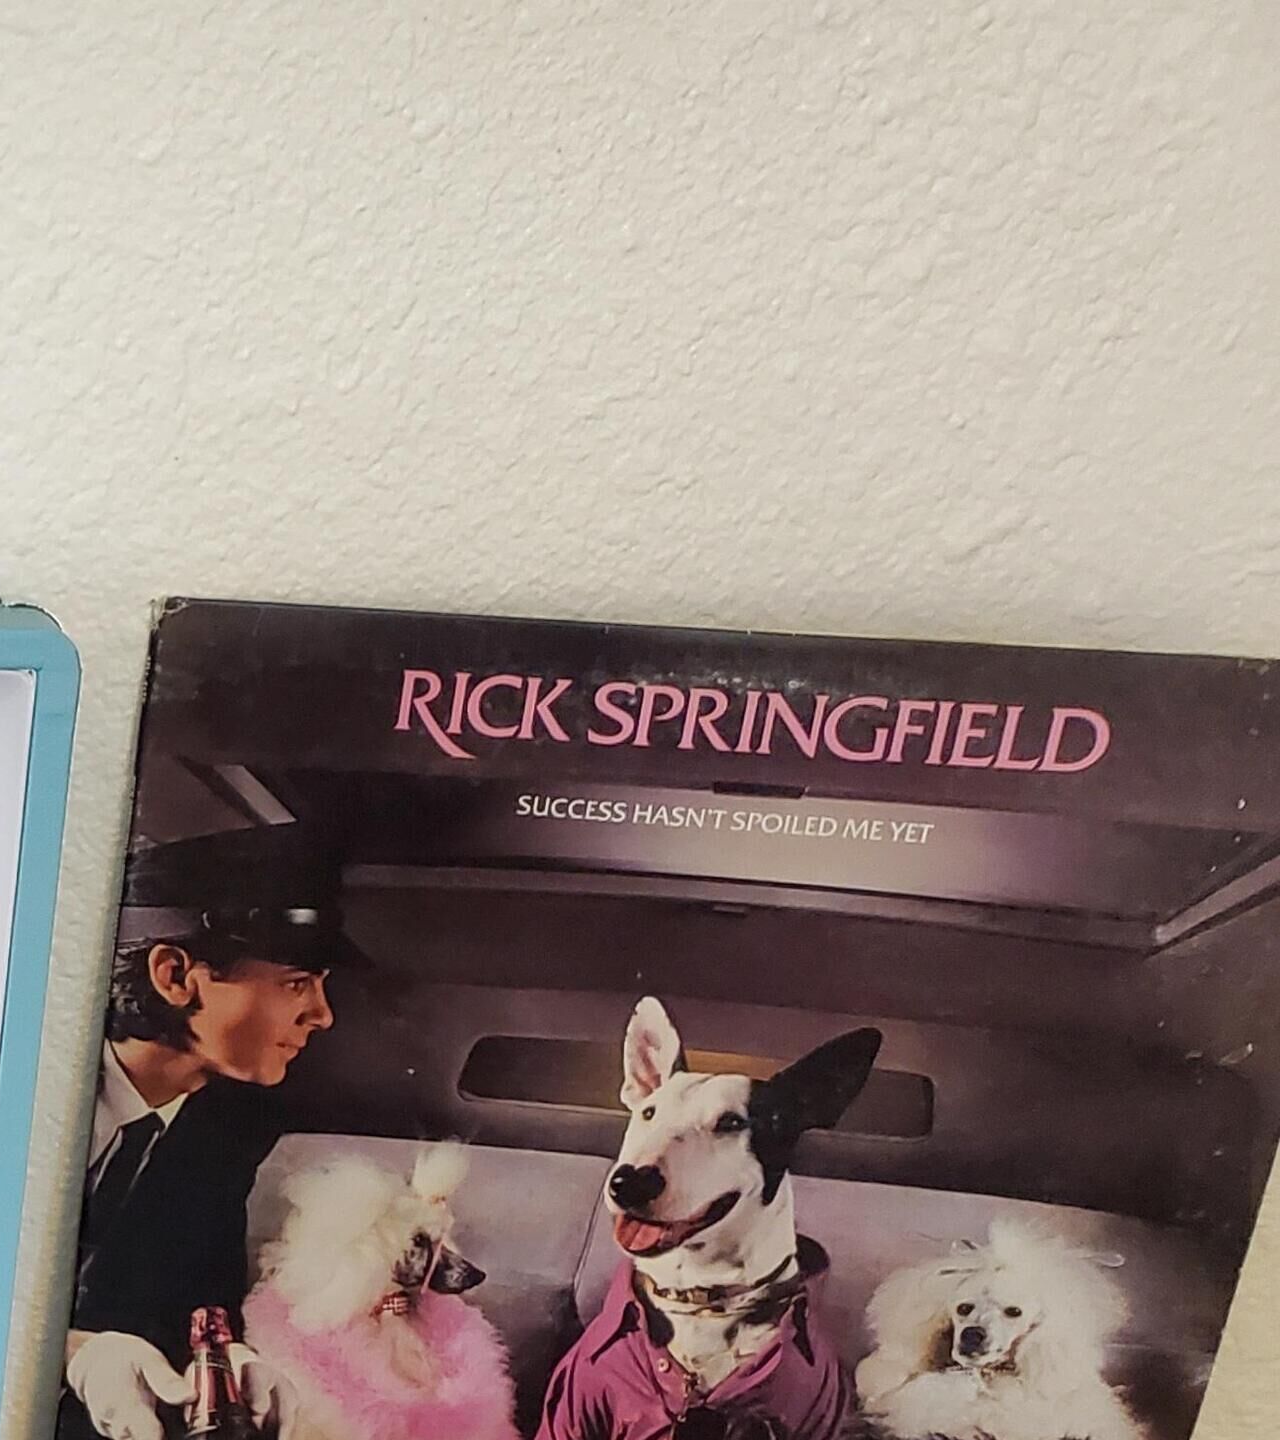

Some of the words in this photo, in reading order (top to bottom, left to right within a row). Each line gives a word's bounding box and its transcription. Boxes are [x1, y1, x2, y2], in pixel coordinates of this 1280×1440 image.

[393, 668, 572, 759] RICK
[586, 680, 1111, 774] SPRINGFIELD
[516, 794, 628, 823] SUCCESS
[632, 803, 728, 830] HASN'T
[730, 811, 838, 837] SPOILED
[842, 818, 884, 841] ME
[889, 821, 935, 844] YET
